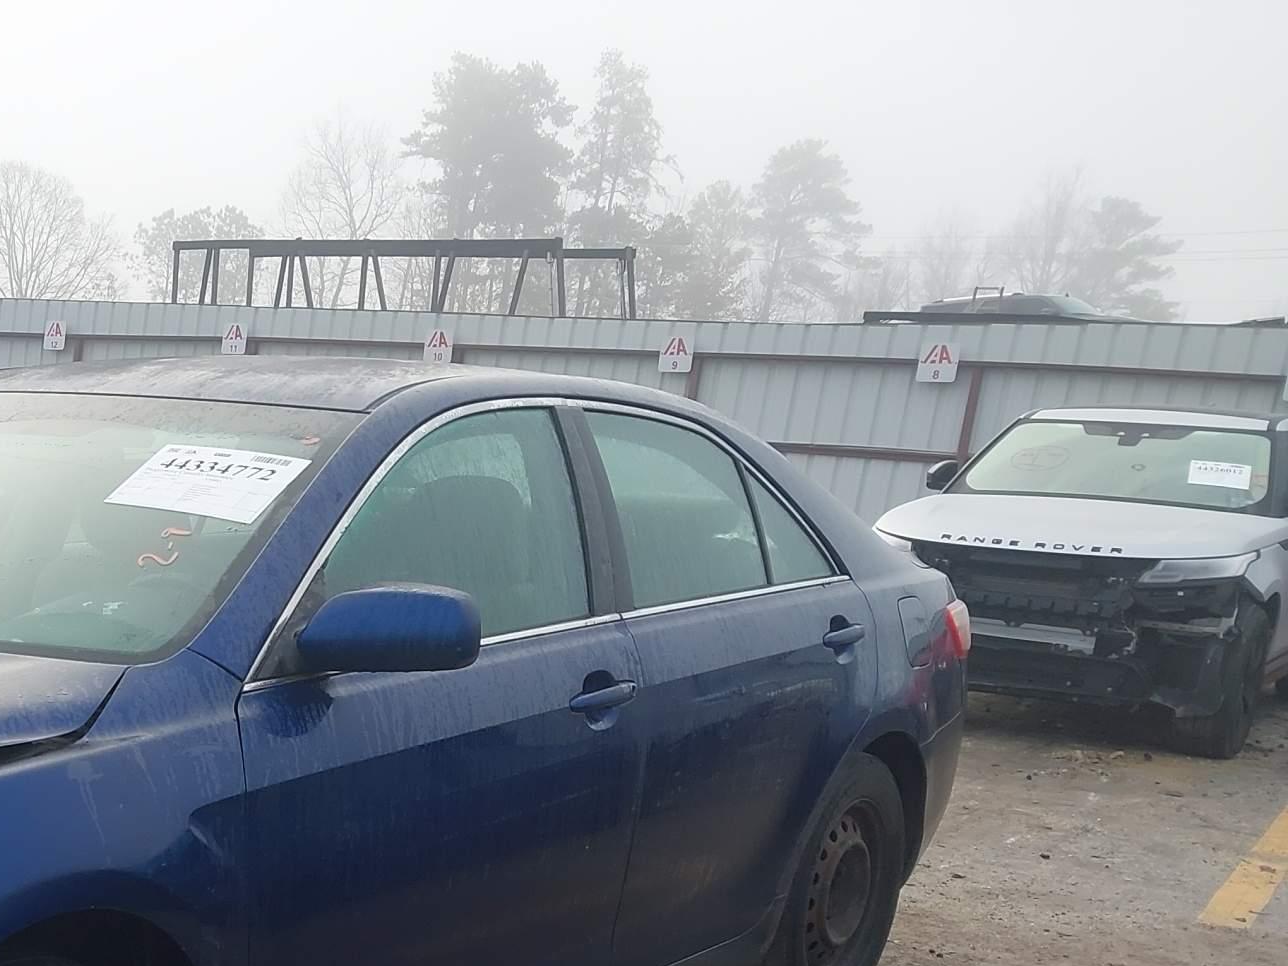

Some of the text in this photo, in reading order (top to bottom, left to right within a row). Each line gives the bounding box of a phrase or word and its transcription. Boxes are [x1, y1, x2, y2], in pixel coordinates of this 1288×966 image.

[51, 341, 58, 349] 12
[229, 344, 238, 353] 11
[433, 352, 443, 361] 10
[672, 360, 678, 370] 9
[932, 369, 940, 380] 8
[160, 457, 277, 481] 44334772
[940, 533, 1123, 554] RANGE ROVER
